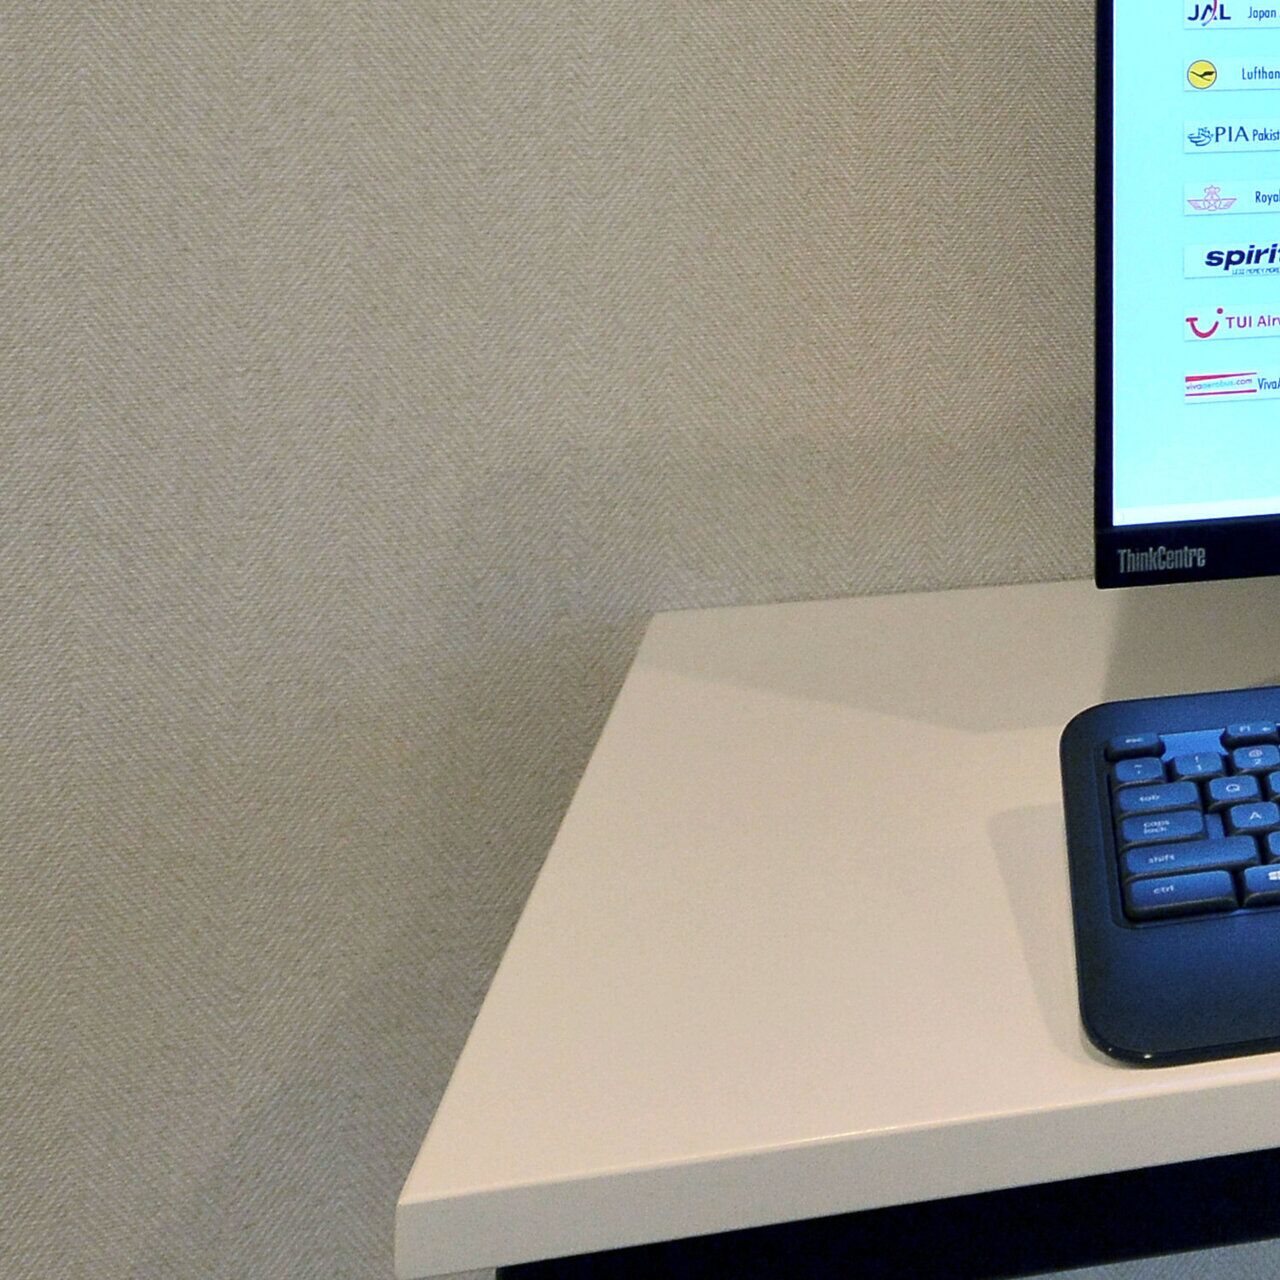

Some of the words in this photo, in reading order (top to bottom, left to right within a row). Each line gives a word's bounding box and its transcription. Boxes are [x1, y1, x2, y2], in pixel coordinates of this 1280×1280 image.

[1187, 0, 1231, 23] JAL
[1248, 7, 1277, 21] Japan
[1215, 126, 1249, 142] PIA
[1255, 190, 1280, 206] Royal
[1226, 316, 1252, 329] TUI
[1118, 546, 1205, 572] ThinkCentre
